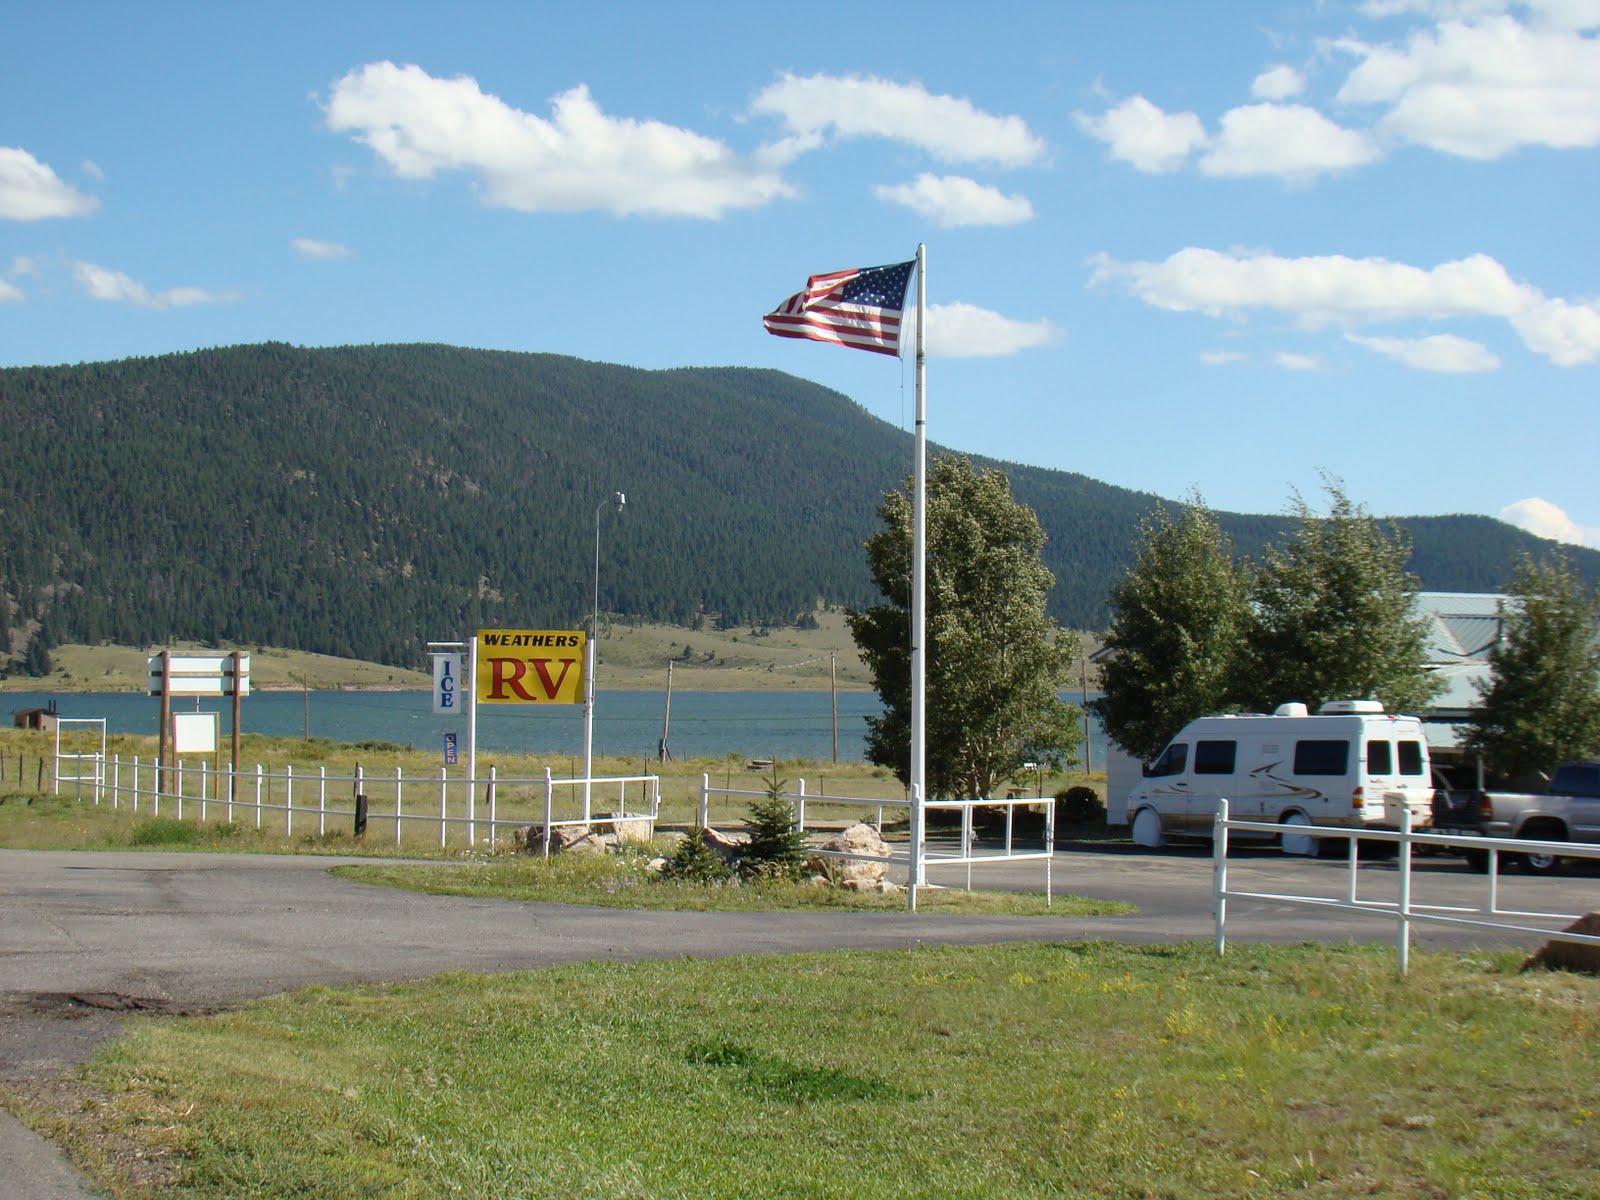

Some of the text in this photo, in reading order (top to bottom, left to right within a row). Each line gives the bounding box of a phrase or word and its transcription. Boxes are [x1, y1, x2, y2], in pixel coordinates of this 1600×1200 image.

[484, 634, 579, 647] WEATHERS
[440, 661, 454, 707] ICE
[486, 657, 576, 700] RV
[446, 735, 455, 763] OPEN
